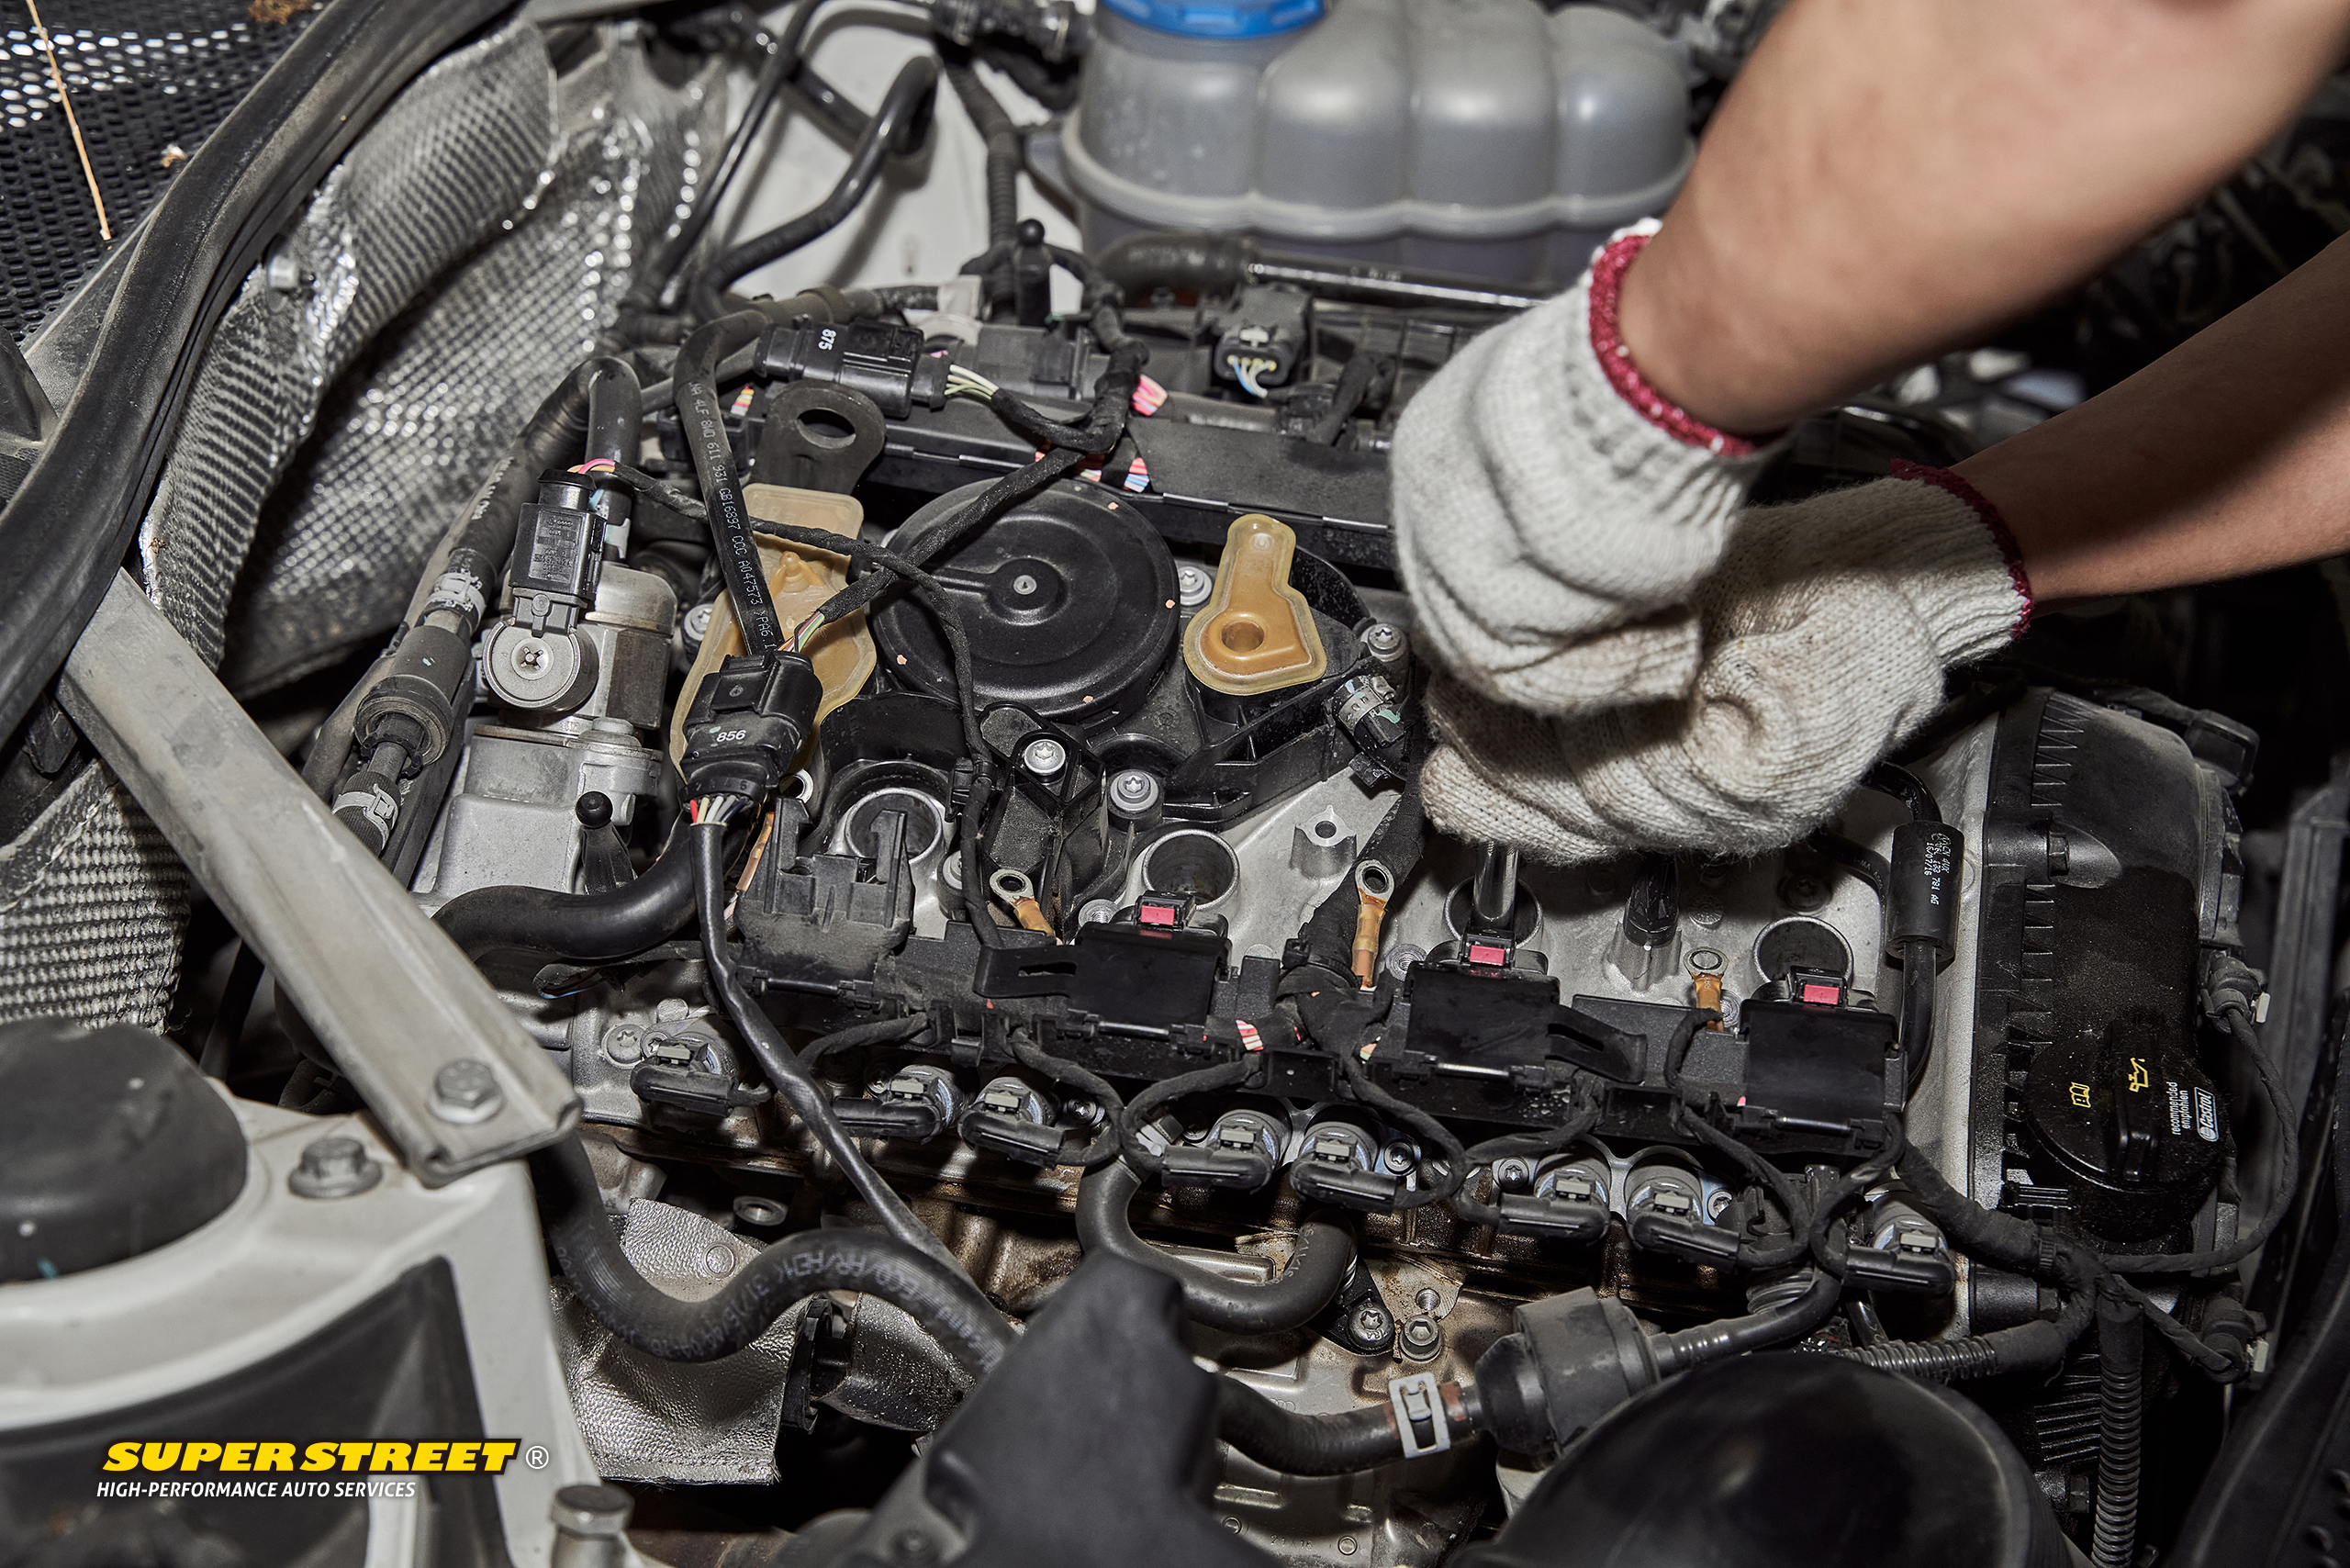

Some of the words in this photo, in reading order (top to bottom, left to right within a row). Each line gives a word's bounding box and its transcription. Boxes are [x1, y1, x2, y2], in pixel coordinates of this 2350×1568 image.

[818, 329, 837, 351] 875
[707, 442, 722, 461] 611
[712, 465, 729, 484] 931
[716, 729, 746, 742] 856
[1930, 877, 1941, 890] 781
[1930, 893, 1940, 905] AG
[2166, 1081, 2181, 1136] recommended
[2177, 1090, 2192, 1129] empfohlen
[2198, 1092, 2214, 1128] Castrol
